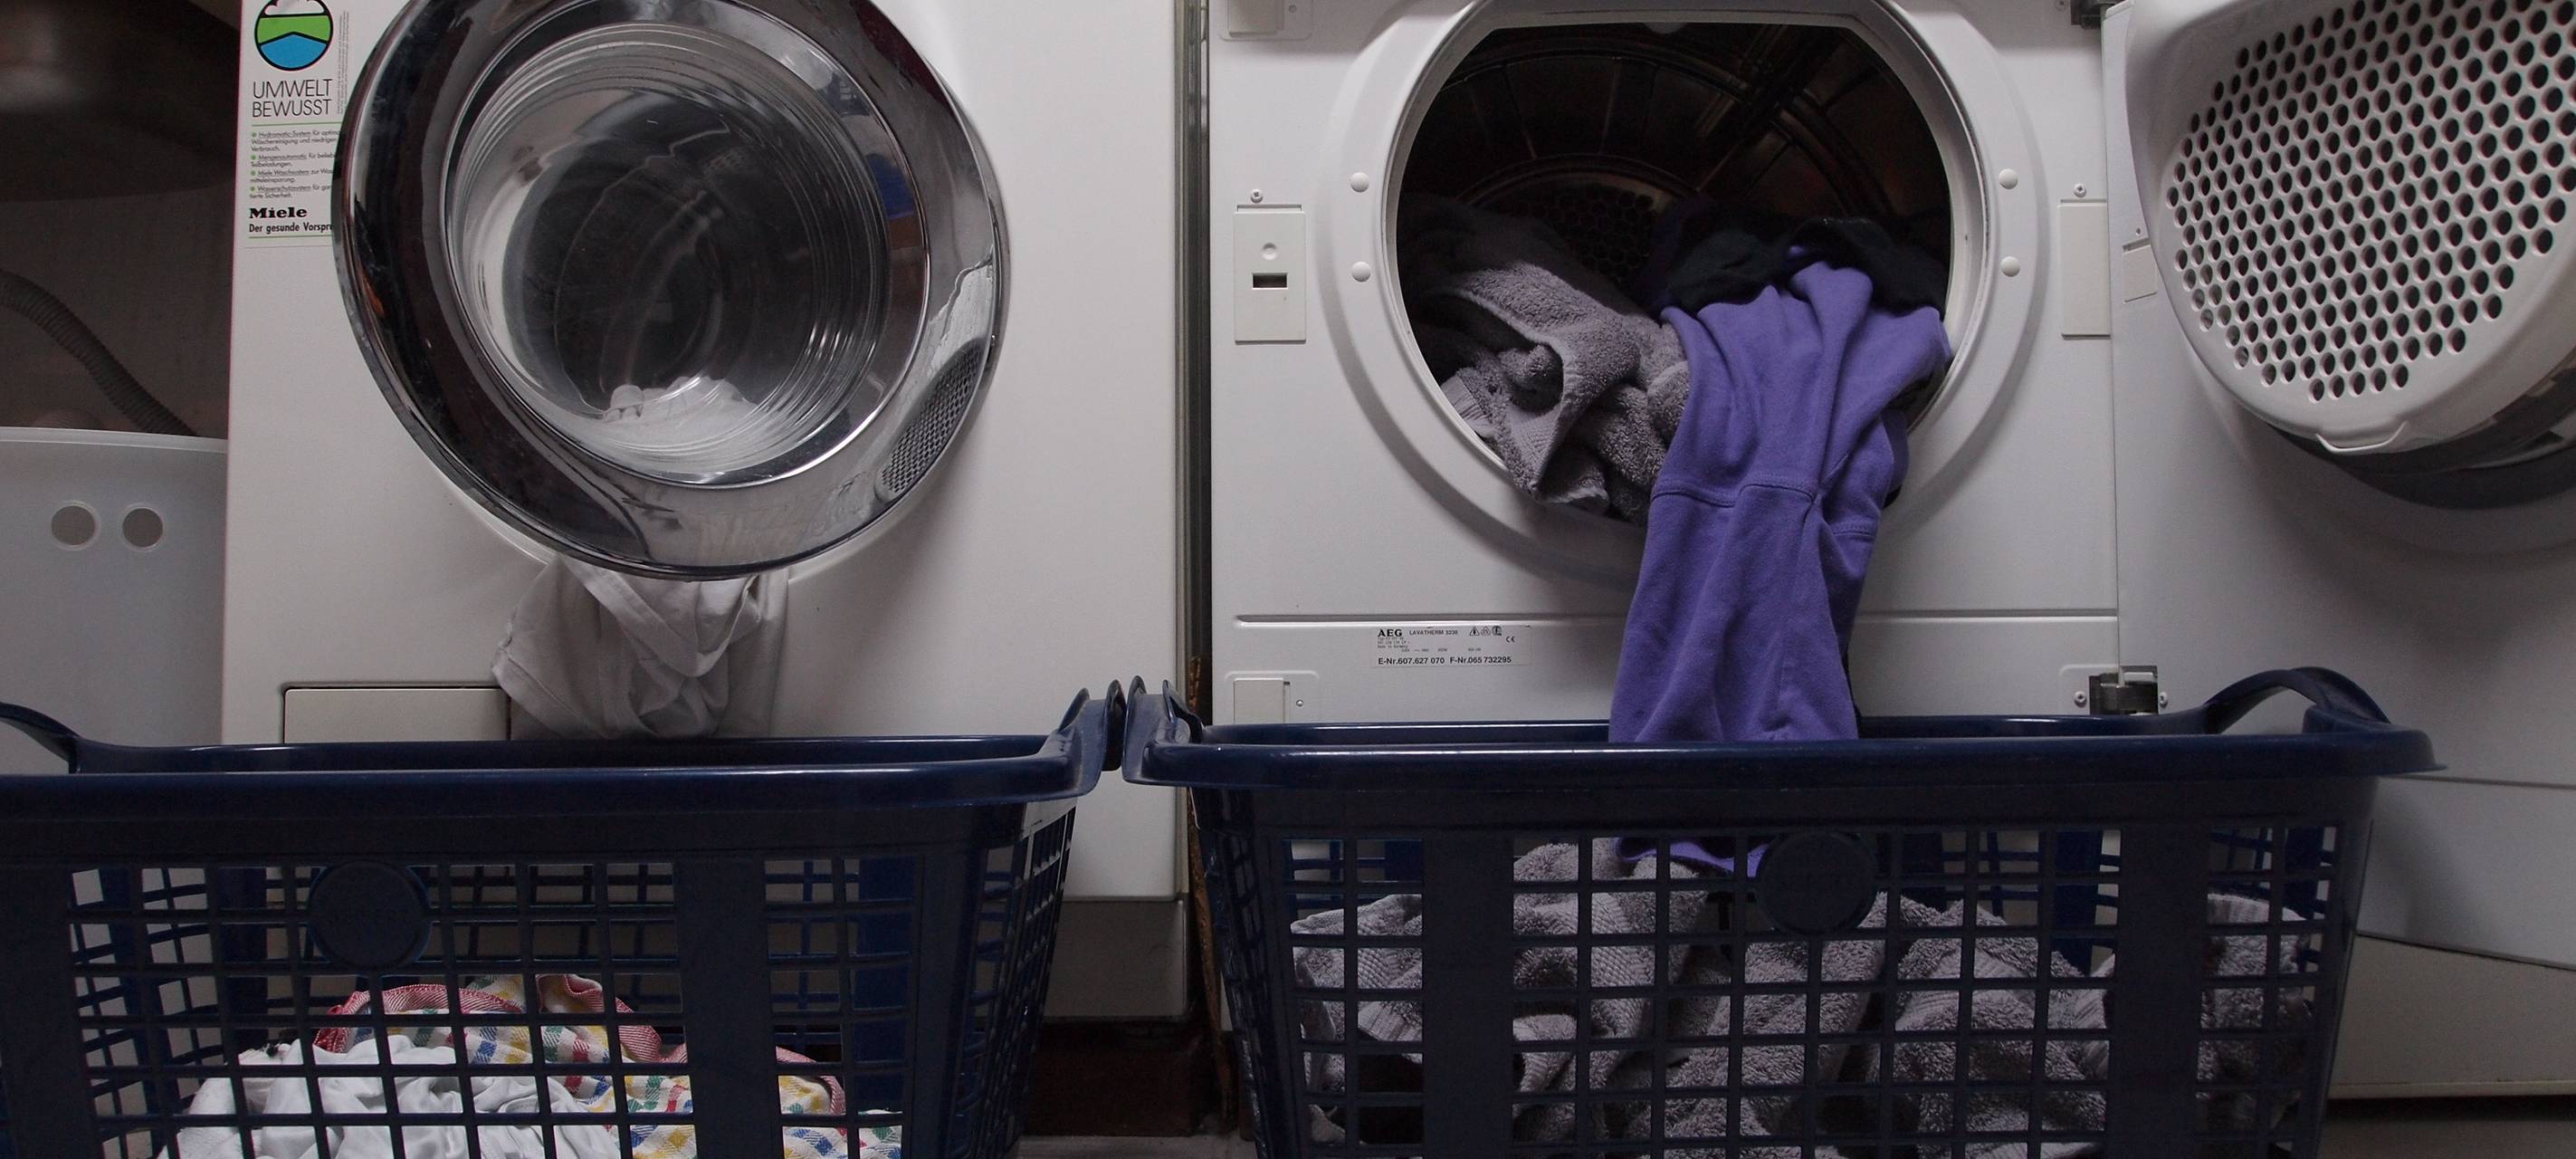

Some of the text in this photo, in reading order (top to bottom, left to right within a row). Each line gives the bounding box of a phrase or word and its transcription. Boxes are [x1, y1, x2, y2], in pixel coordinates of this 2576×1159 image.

[253, 79, 333, 99] UMWELT
[253, 99, 332, 118] BEWUSST
[249, 206, 308, 218] Miele
[249, 224, 262, 233] Der
[266, 222, 300, 235] gesunde
[1378, 628, 1403, 637] AEG
[1484, 656, 1512, 664] 732295
